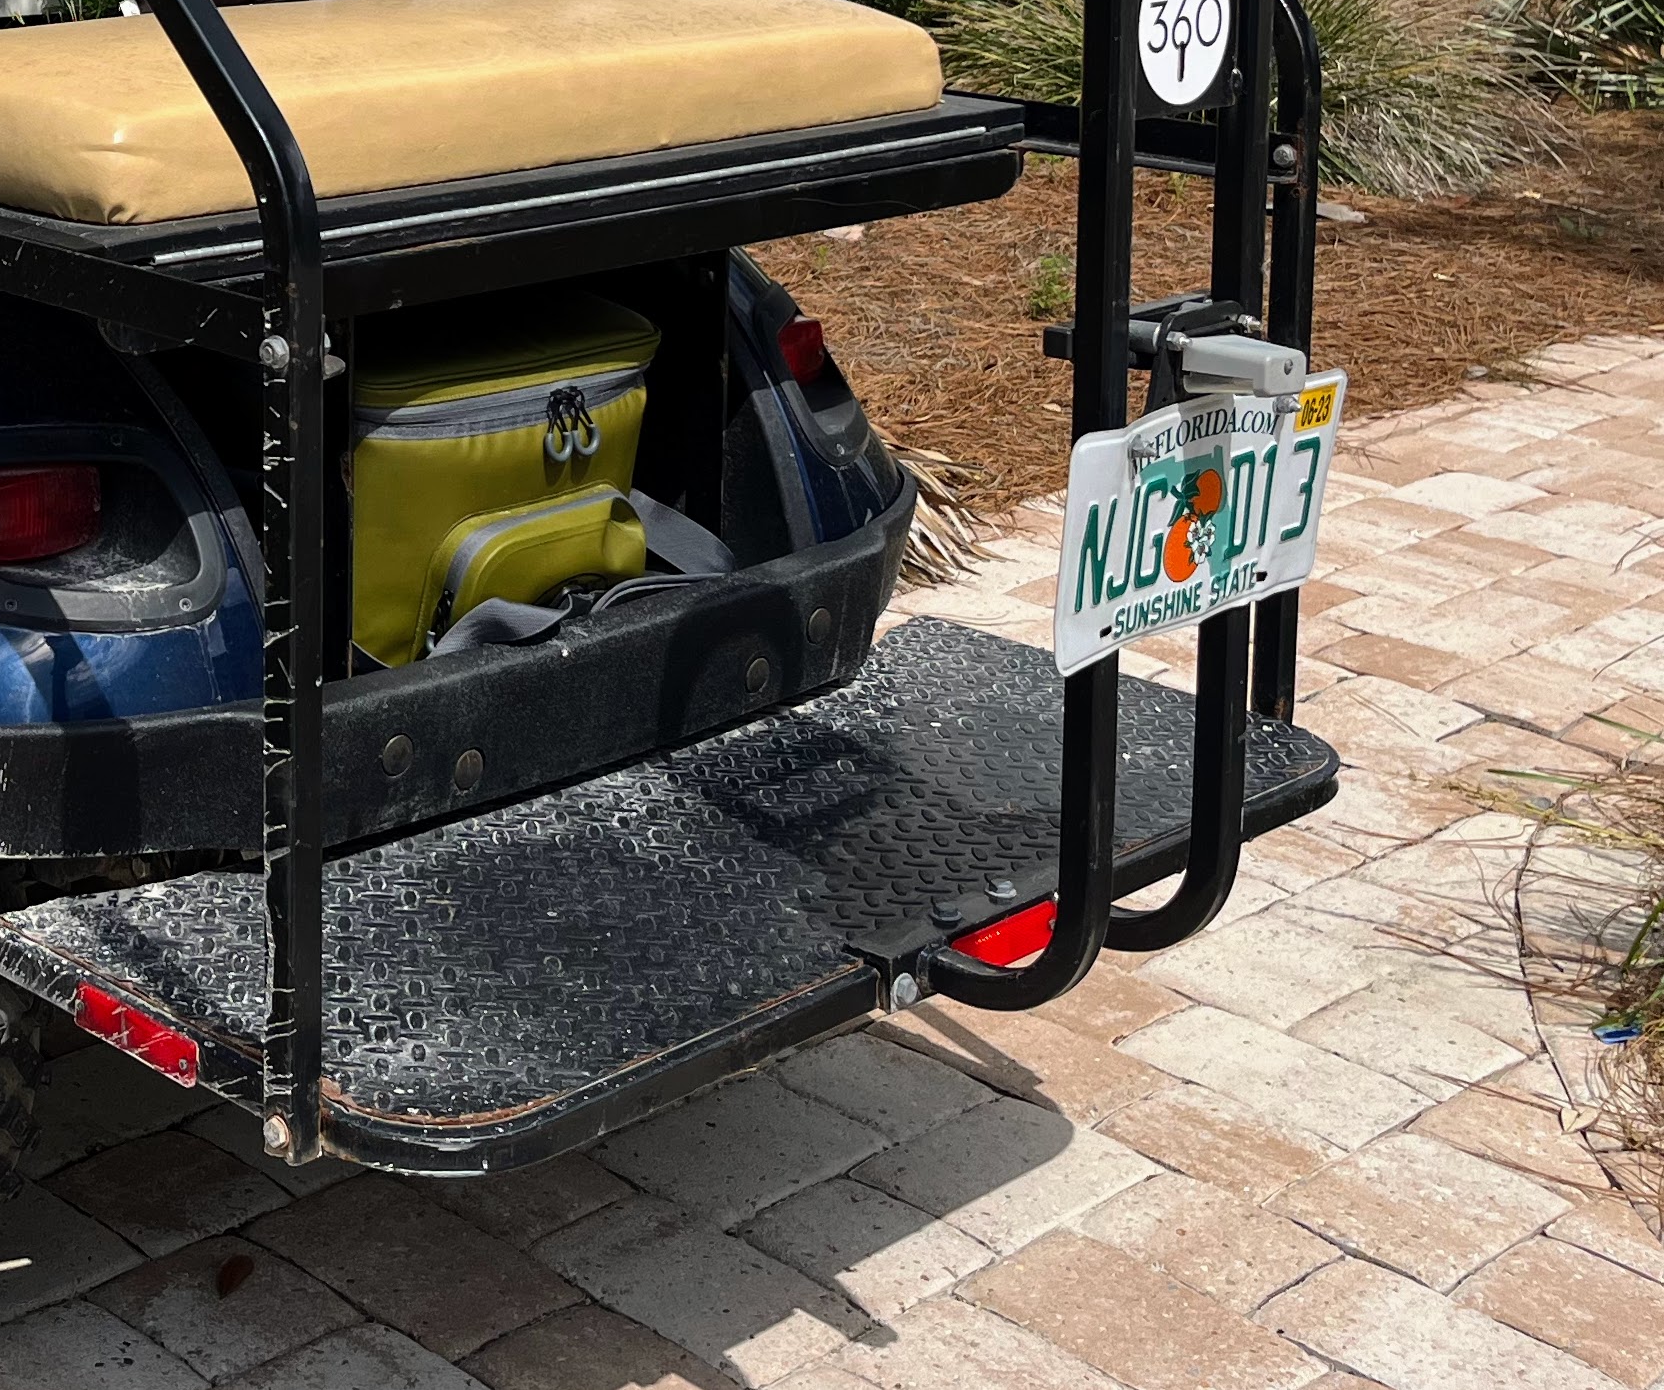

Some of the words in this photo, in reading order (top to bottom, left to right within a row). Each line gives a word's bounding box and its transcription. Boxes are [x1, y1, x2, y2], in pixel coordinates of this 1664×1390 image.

[1300, 393, 1332, 427] 06-23
[1073, 476, 1169, 614] NJG
[1222, 435, 1322, 562] D13
[1110, 580, 1203, 641] SUNSHINE
[1207, 561, 1259, 608] STATE
